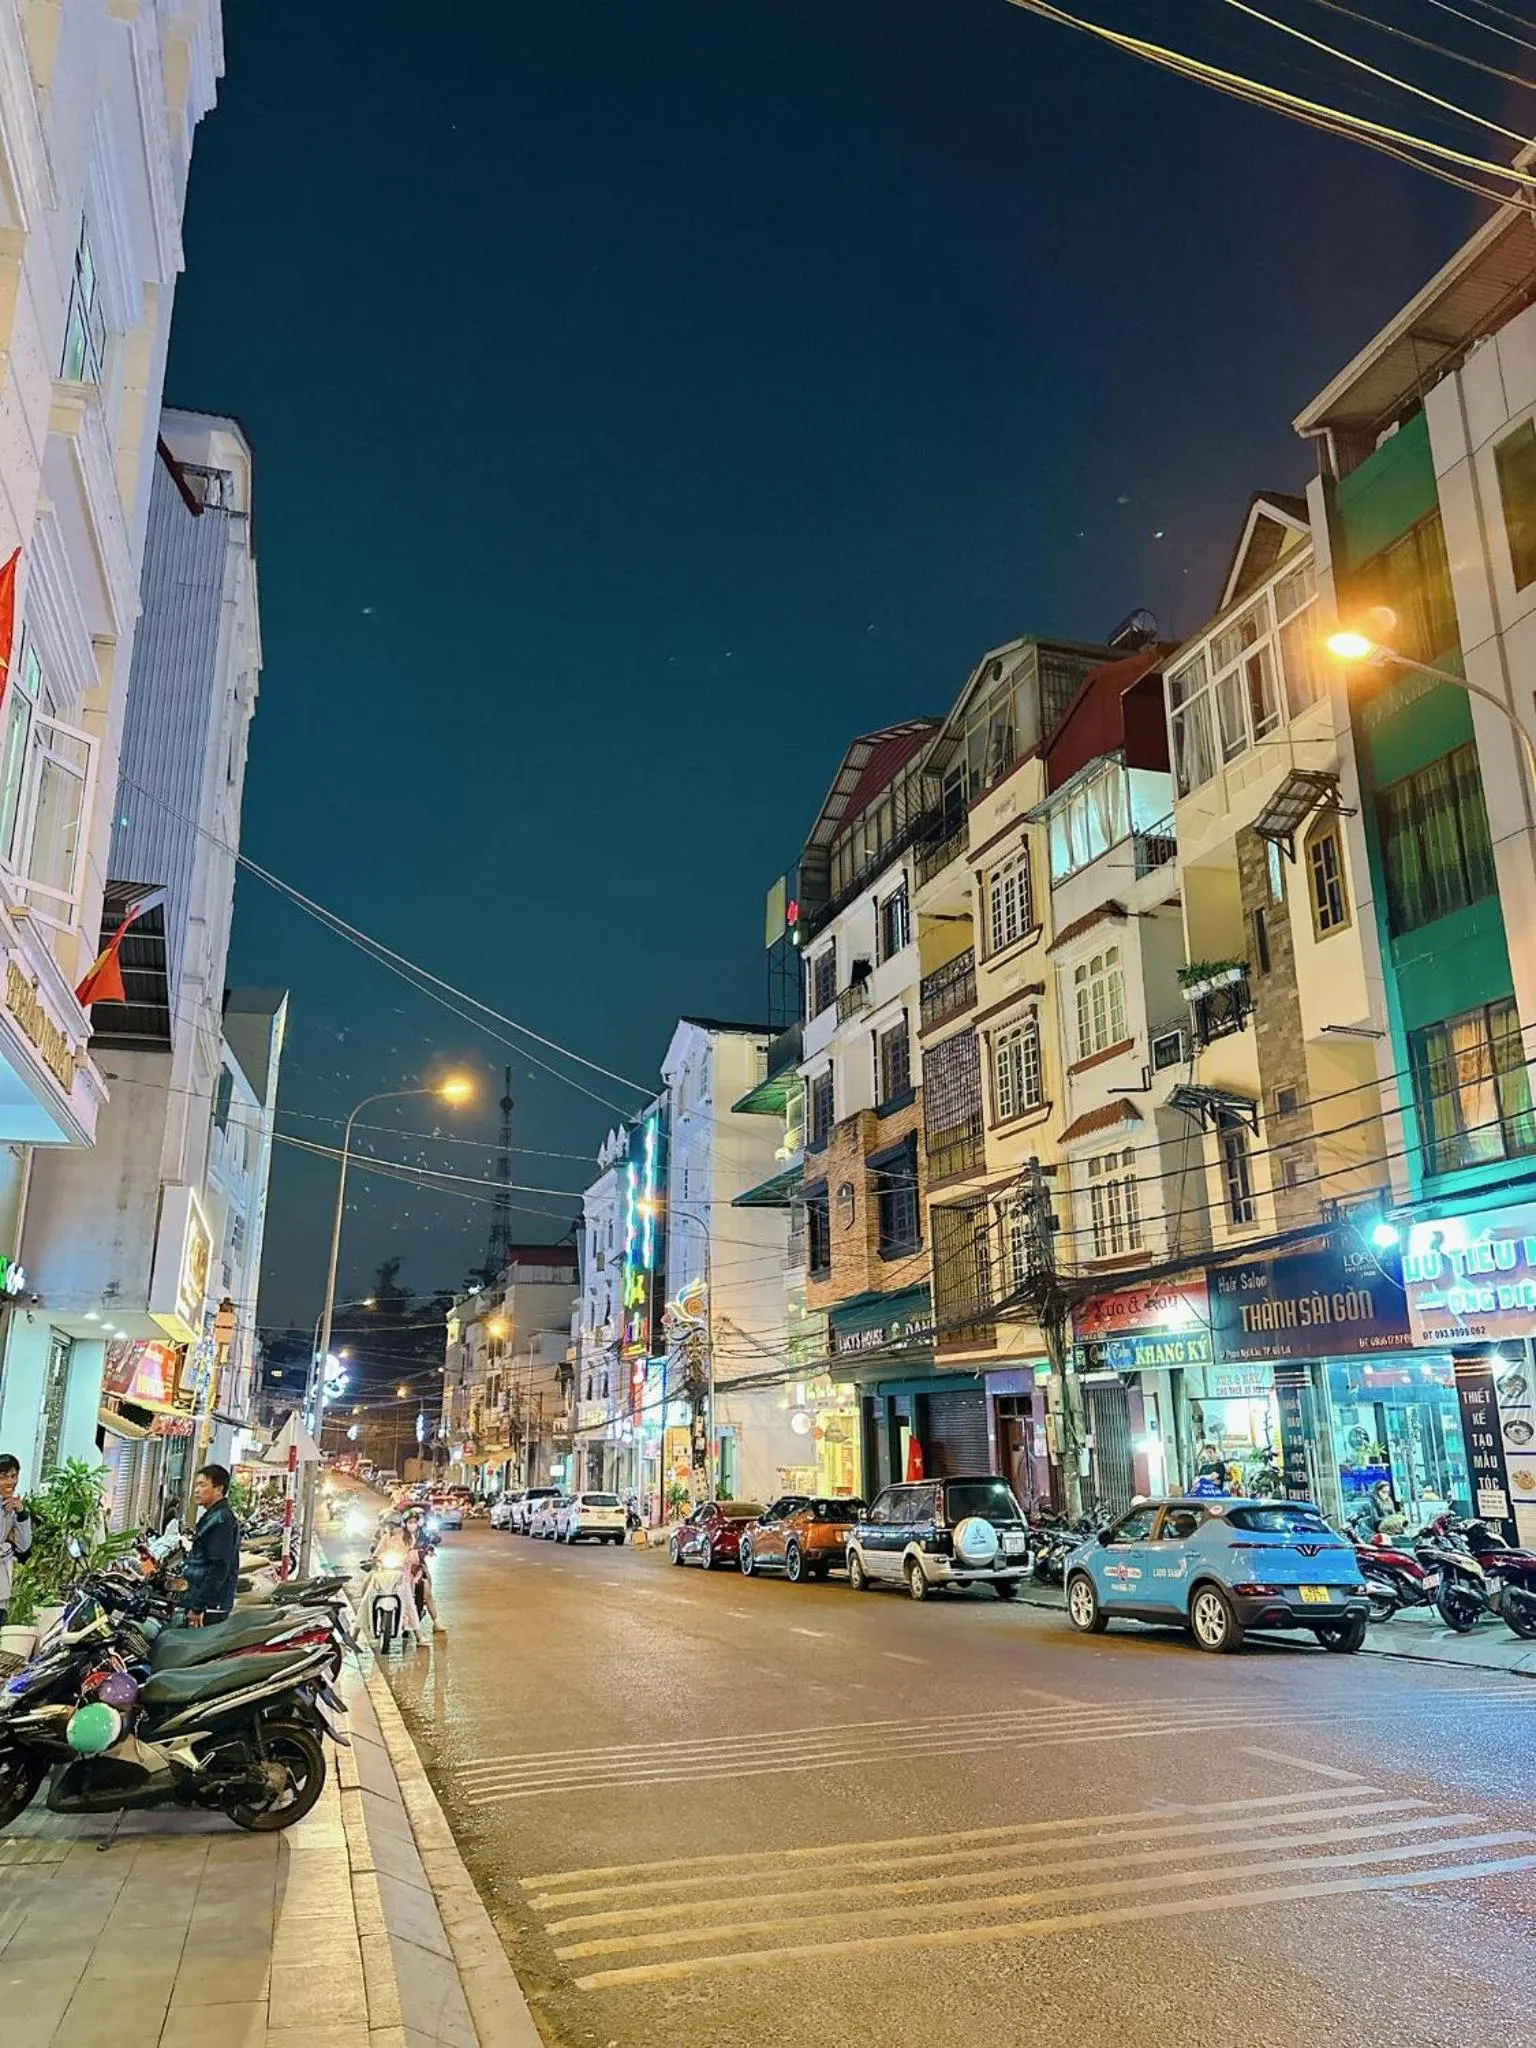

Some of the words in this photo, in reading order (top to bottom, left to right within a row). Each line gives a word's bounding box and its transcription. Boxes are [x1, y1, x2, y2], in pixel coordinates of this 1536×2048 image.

[1217, 1275, 1237, 1294] Hair
[1240, 1273, 1267, 1290] Salon
[1239, 1297, 1298, 1333] THÀNH
[1300, 1290, 1331, 1327] SÀI
[1333, 1286, 1374, 1321] GÒN
[1135, 1341, 1186, 1365] KHANG
[1187, 1334, 1209, 1360] KÝ
[1462, 1387, 1490, 1404] THIẾT
[1472, 1433, 1493, 1450] TẠO
[1478, 1474, 1499, 1490] TÓC
